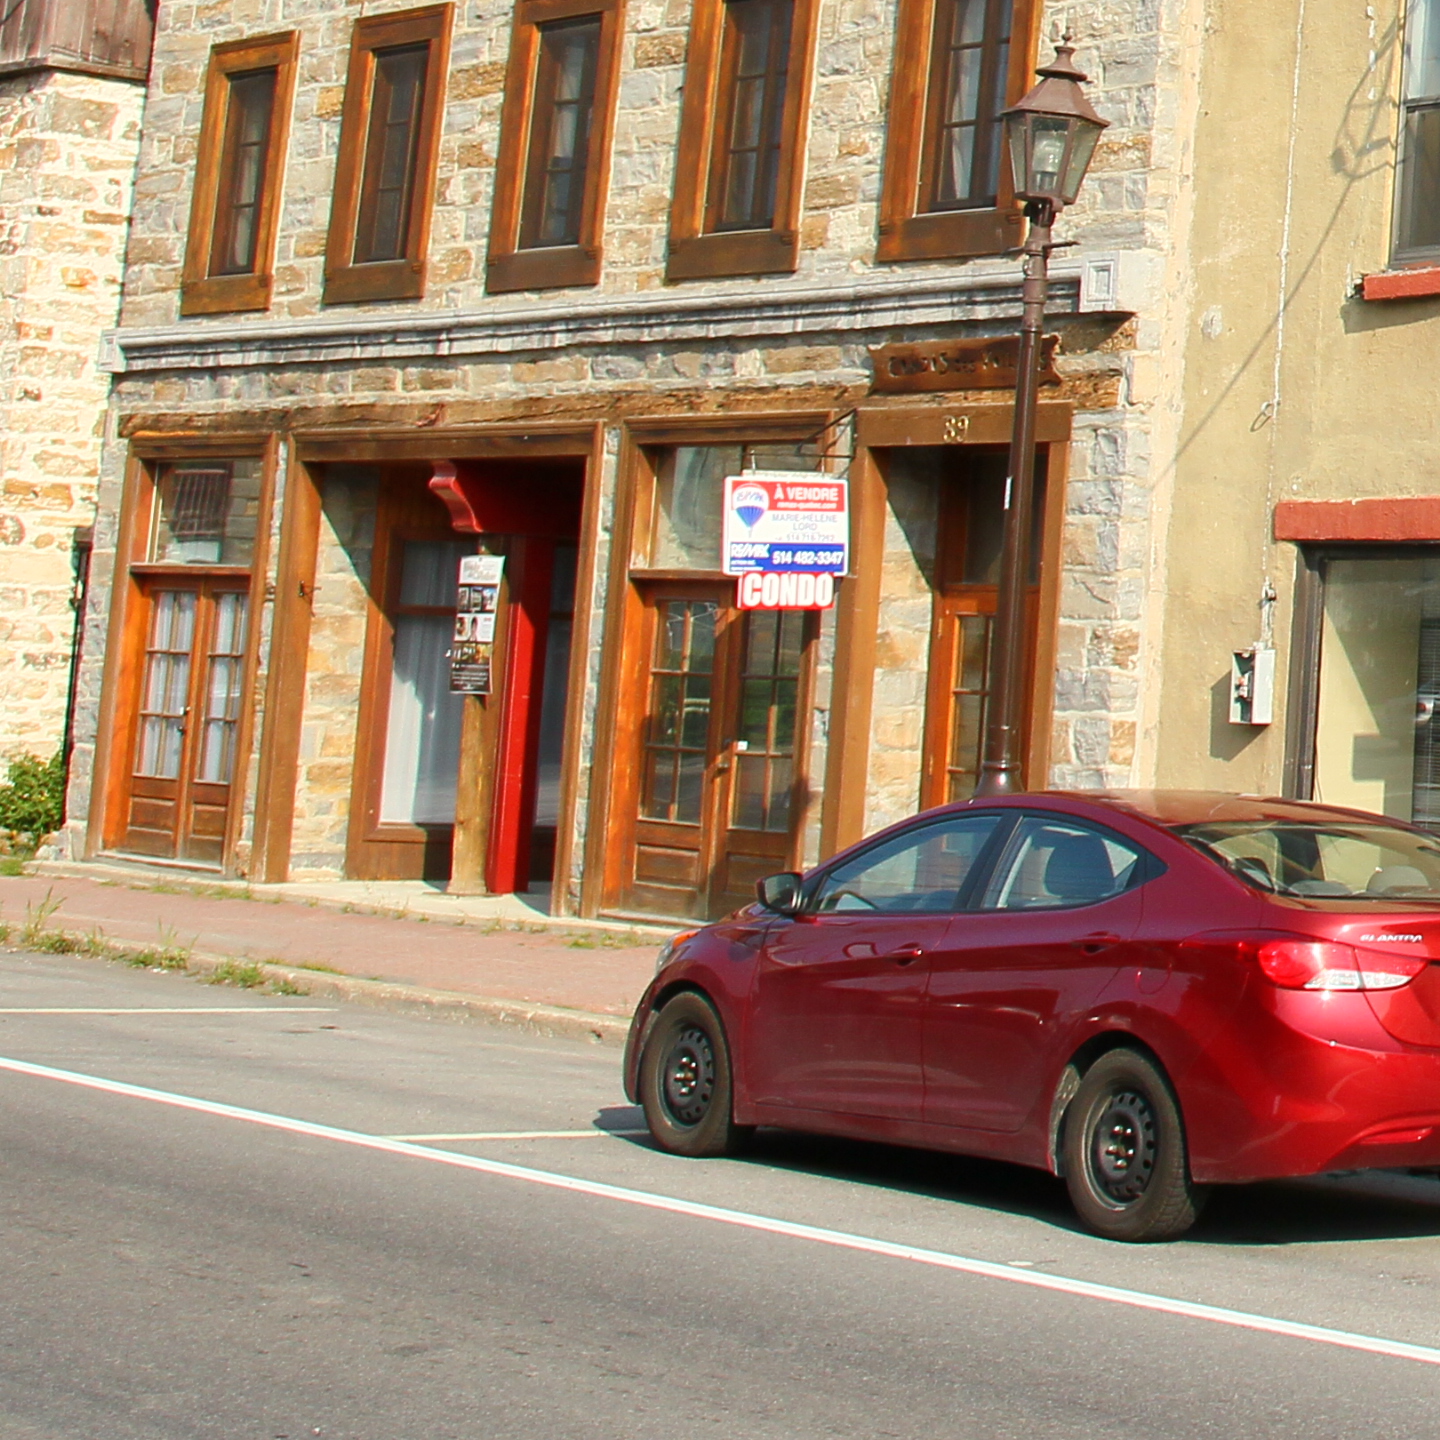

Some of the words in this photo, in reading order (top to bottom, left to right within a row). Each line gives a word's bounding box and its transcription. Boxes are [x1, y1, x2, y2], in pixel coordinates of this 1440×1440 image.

[942, 415, 969, 443] 89
[774, 483, 784, 500] À
[786, 487, 838, 501] VENDRE
[772, 551, 792, 565] 514
[742, 572, 834, 607] CONDO
[1360, 934, 1423, 943] ELANTRA
